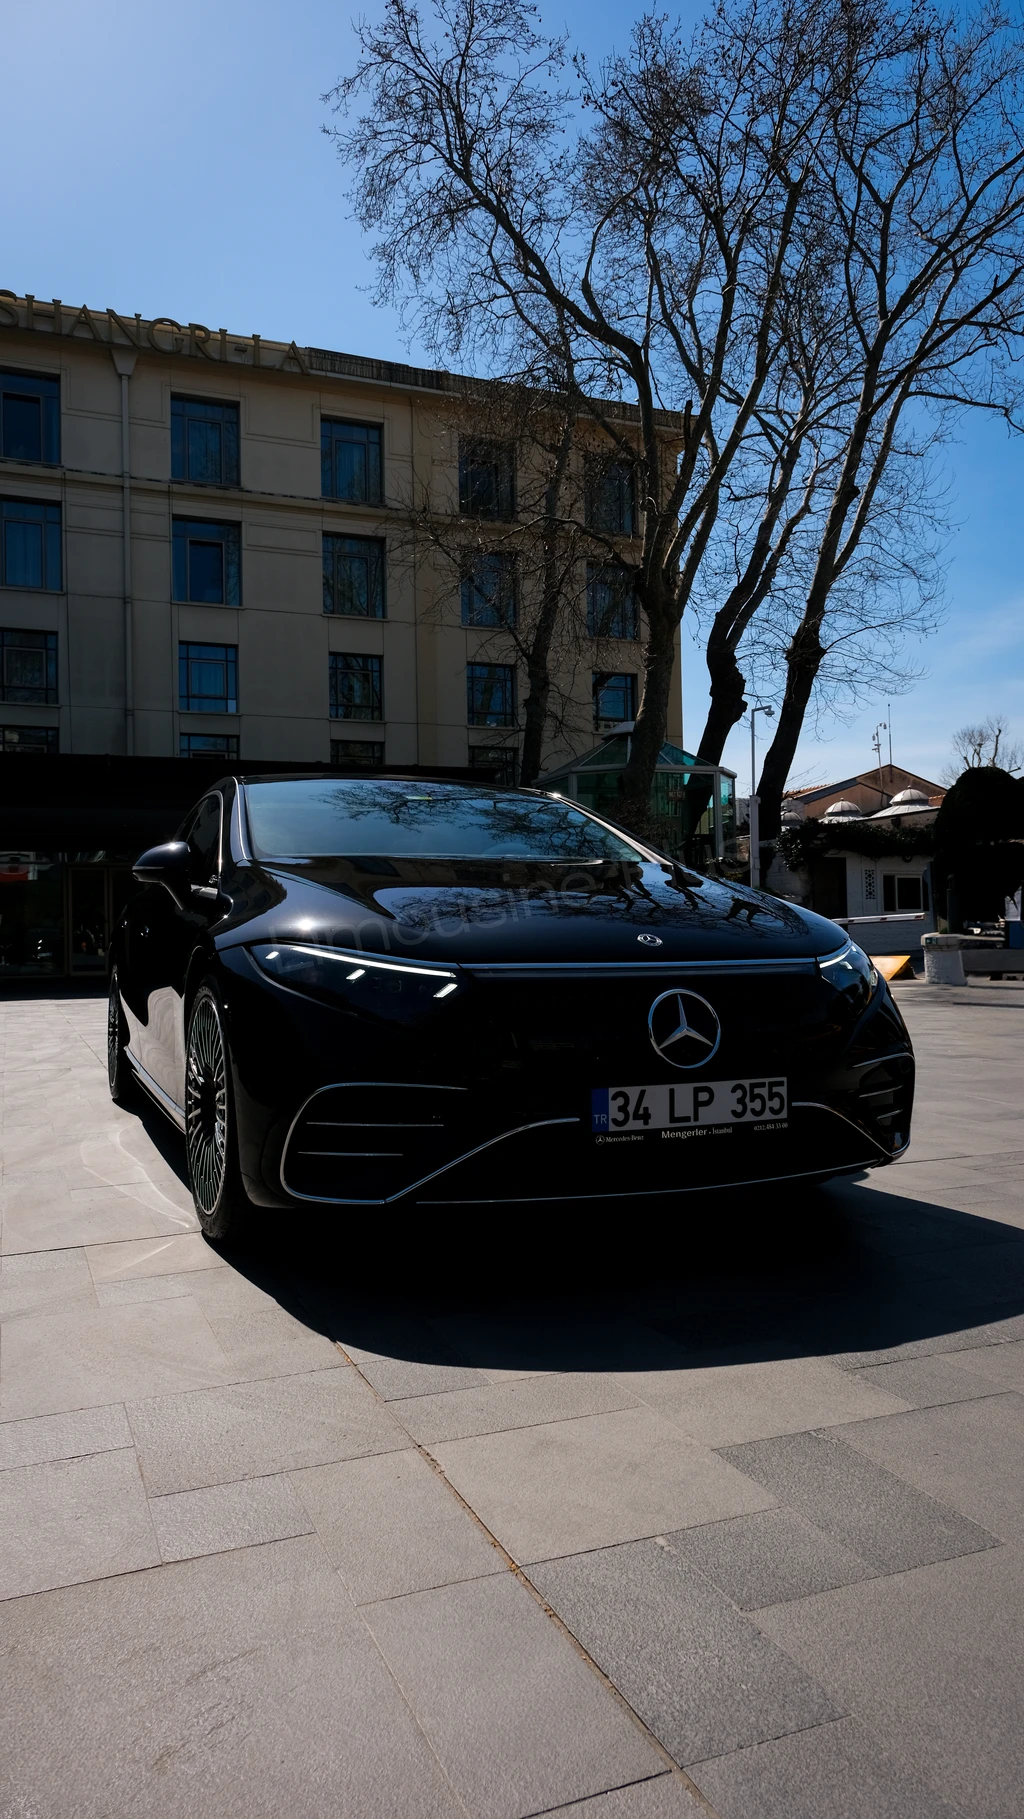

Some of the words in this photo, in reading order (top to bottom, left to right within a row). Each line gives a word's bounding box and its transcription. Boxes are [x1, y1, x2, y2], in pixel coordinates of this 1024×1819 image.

[0, 289, 310, 375] SHANGRI-LA
[611, 1090, 651, 1126] 34
[669, 1086, 715, 1122] LP
[731, 1081, 785, 1118] 355
[593, 1114, 608, 1124] TR
[605, 1134, 644, 1142] Mercedes-Benz
[661, 1129, 707, 1139] Mengerler
